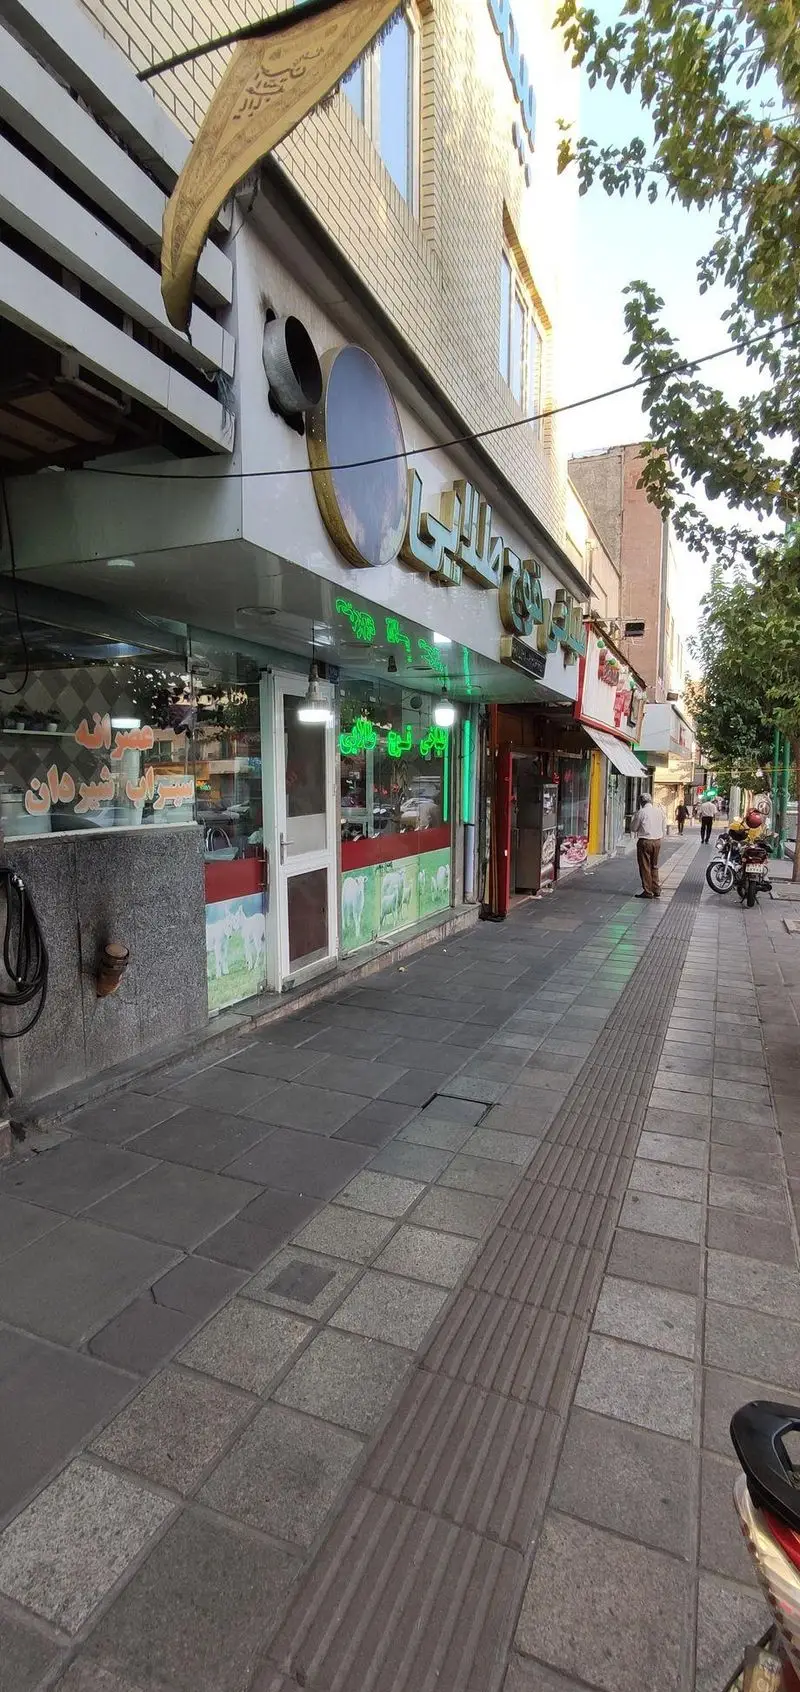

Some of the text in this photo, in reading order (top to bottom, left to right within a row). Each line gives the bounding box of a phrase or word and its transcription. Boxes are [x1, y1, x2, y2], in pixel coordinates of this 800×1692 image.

[398, 467, 505, 590] طلایی
[75, 712, 154, 760] عصرانه
[24, 763, 116, 816] شیردان
